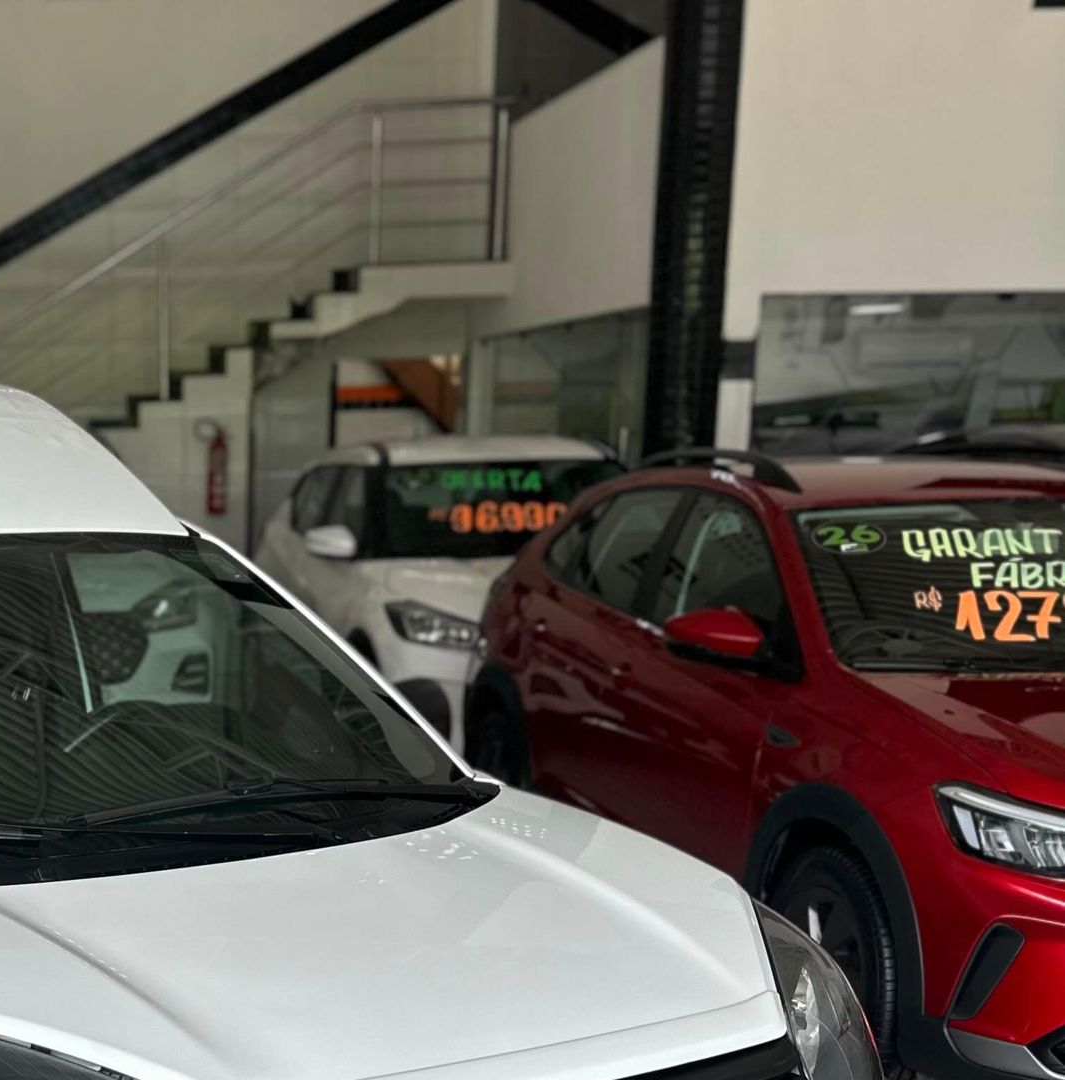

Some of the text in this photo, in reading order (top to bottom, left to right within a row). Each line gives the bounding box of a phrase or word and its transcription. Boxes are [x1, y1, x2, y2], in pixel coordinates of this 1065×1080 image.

[817, 525, 881, 546] 26
[913, 586, 1065, 642] R$ 127
